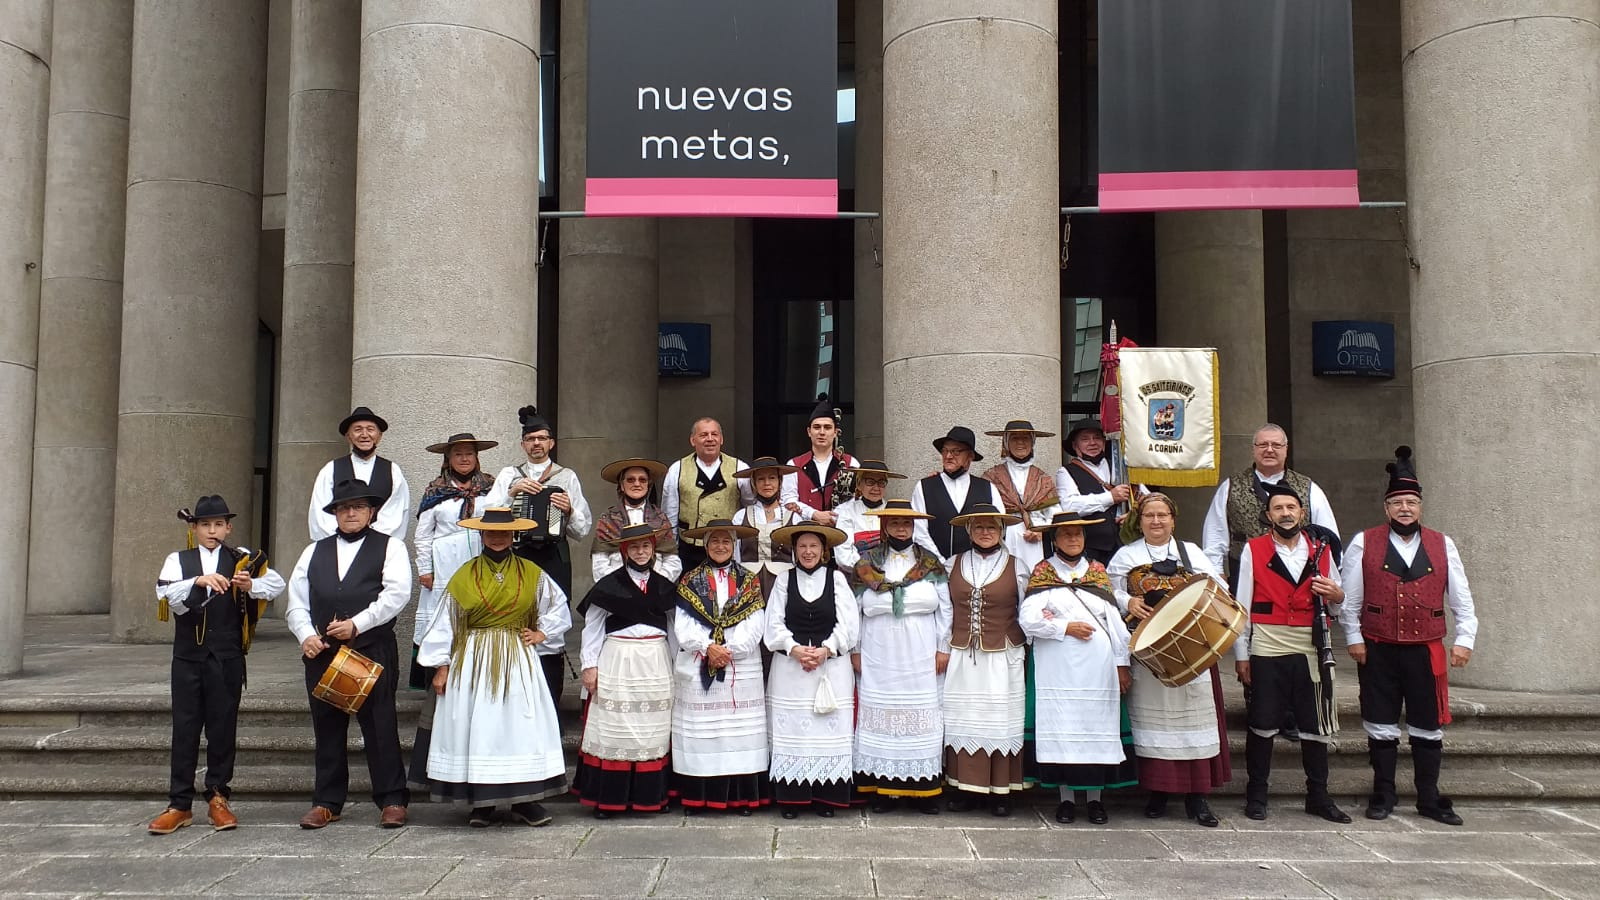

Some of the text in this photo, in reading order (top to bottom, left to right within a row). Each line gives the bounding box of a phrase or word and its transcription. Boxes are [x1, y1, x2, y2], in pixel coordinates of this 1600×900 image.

[638, 87, 793, 111] nuevas
[641, 129, 790, 165] metas,
[1337, 350, 1382, 371] OPERA
[1142, 385, 1151, 395] OS
[1148, 442, 1183, 454] A CORUÑA
